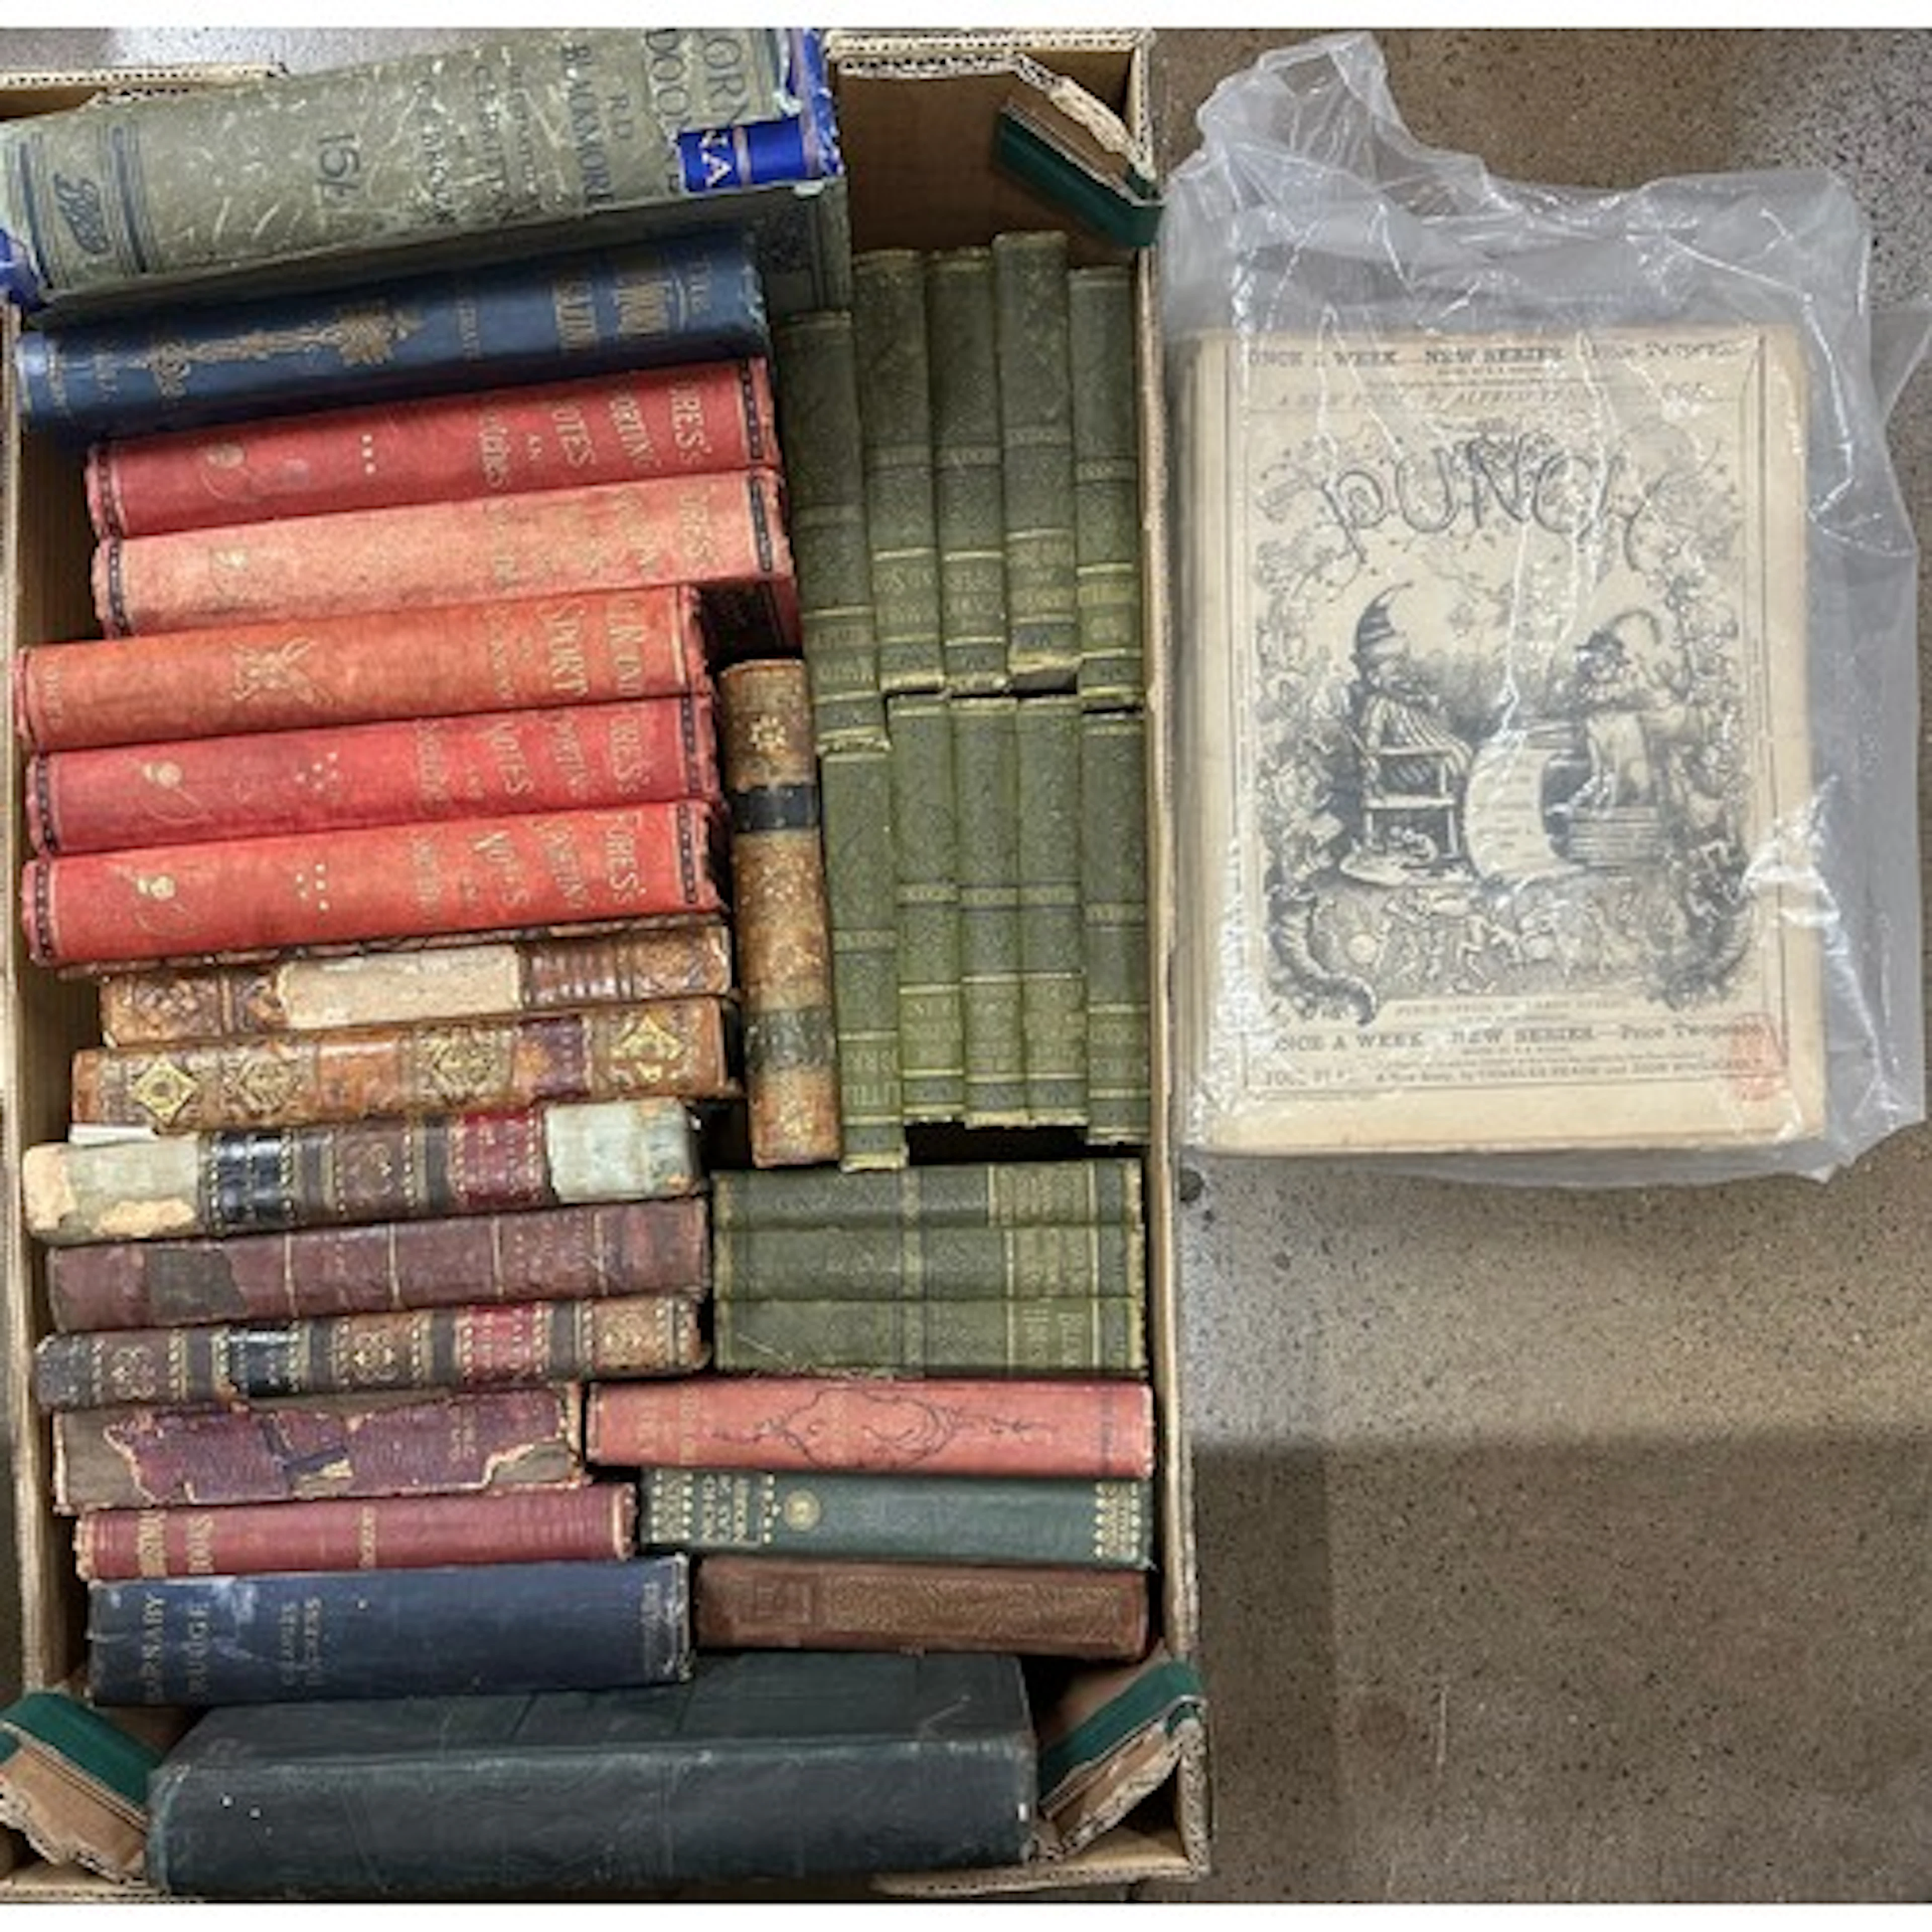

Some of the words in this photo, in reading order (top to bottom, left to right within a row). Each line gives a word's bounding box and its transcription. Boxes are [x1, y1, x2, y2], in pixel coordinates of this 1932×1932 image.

[1332, 350, 1398, 366] WEEK
[1425, 347, 1479, 364] NEW
[1483, 346, 1563, 363] SERIES
[551, 404, 597, 468] OTES
[1333, 1035, 1347, 1051] A
[1357, 1031, 1424, 1049] WEEK
[1619, 1024, 1665, 1040] Price
